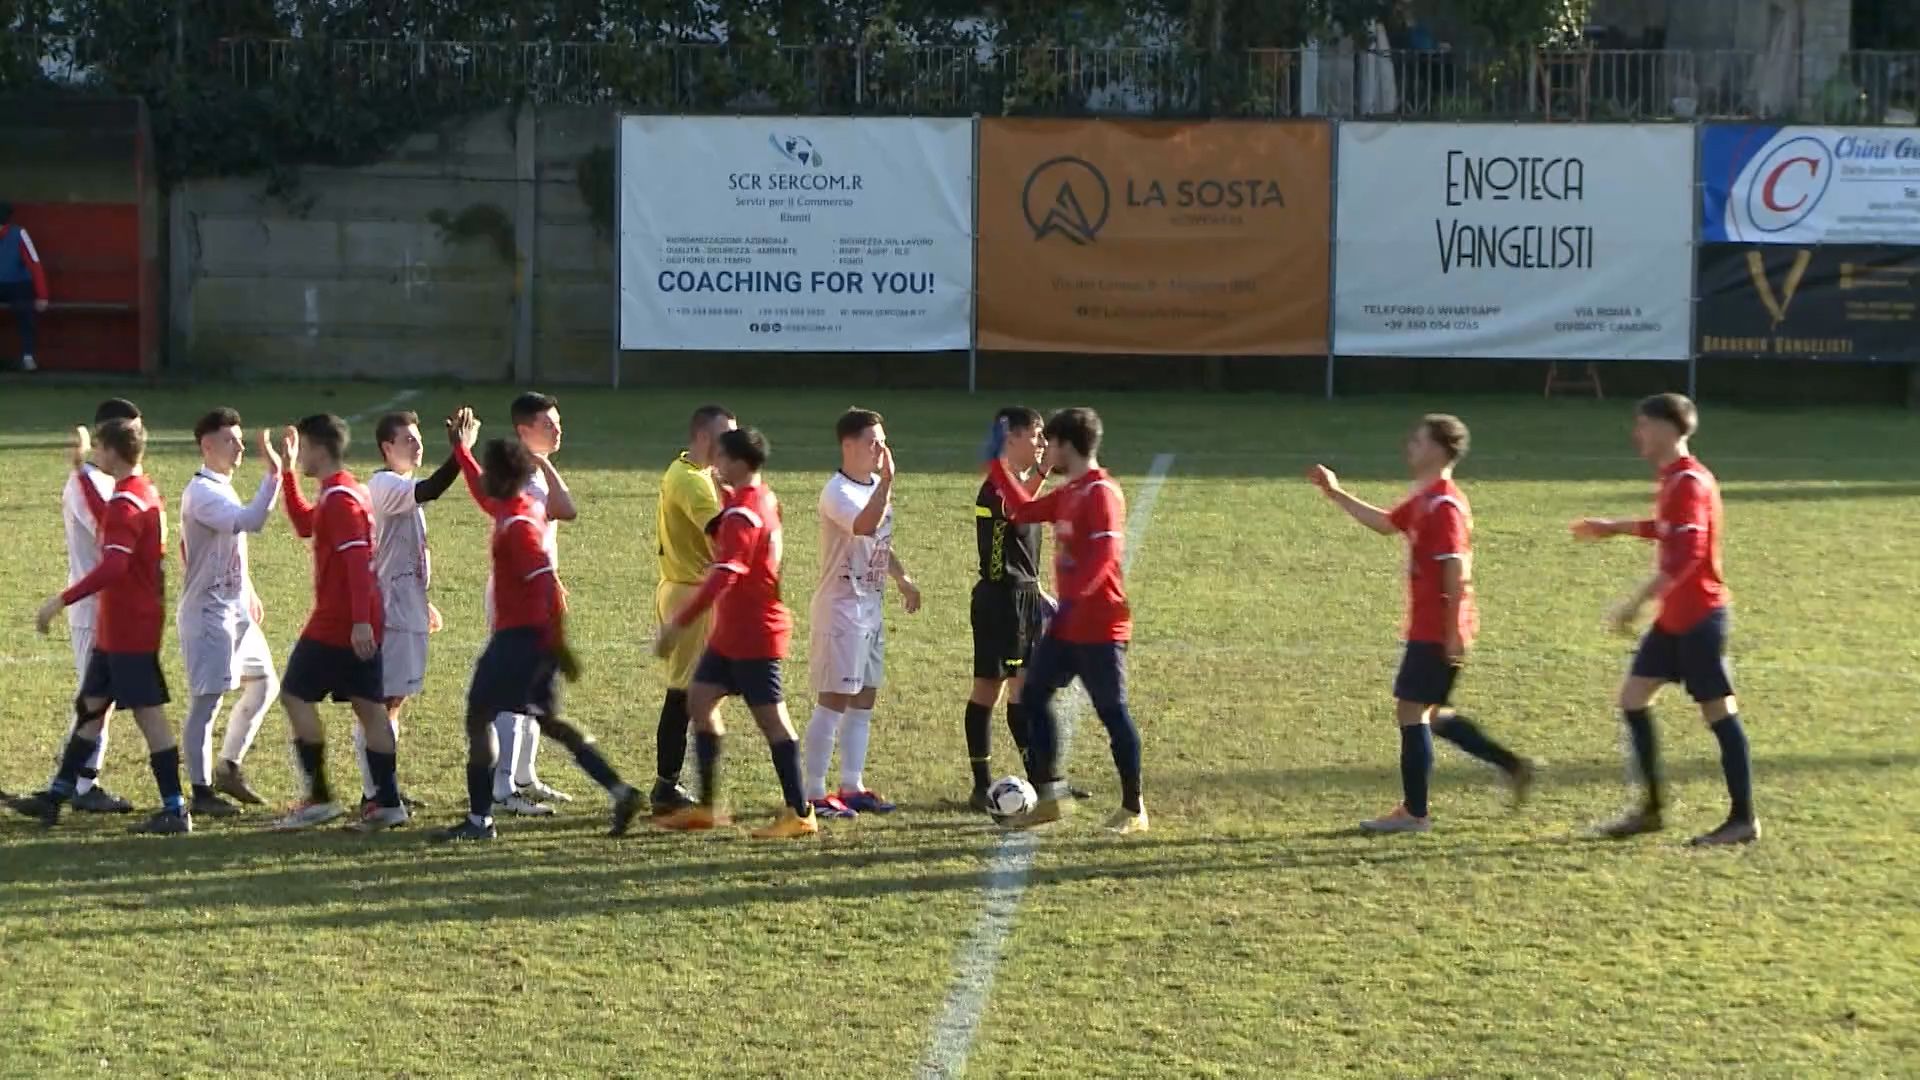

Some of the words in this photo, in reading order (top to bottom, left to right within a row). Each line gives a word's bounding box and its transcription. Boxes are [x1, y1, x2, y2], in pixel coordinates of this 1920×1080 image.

[728, 173, 762, 191] SCR
[768, 174, 864, 191] SERCOM.R
[1762, 156, 1821, 212] C
[768, 199, 784, 209] per
[797, 197, 854, 207] Commercio
[1126, 179, 1167, 208] LA
[1176, 179, 1285, 208] SOSTA
[658, 270, 802, 293] COACHING
[811, 271, 863, 294] FOR
[871, 271, 935, 295] YOU!
[1362, 304, 1425, 316] TELEFONO
[1437, 305, 1502, 316] WHATSAPP
